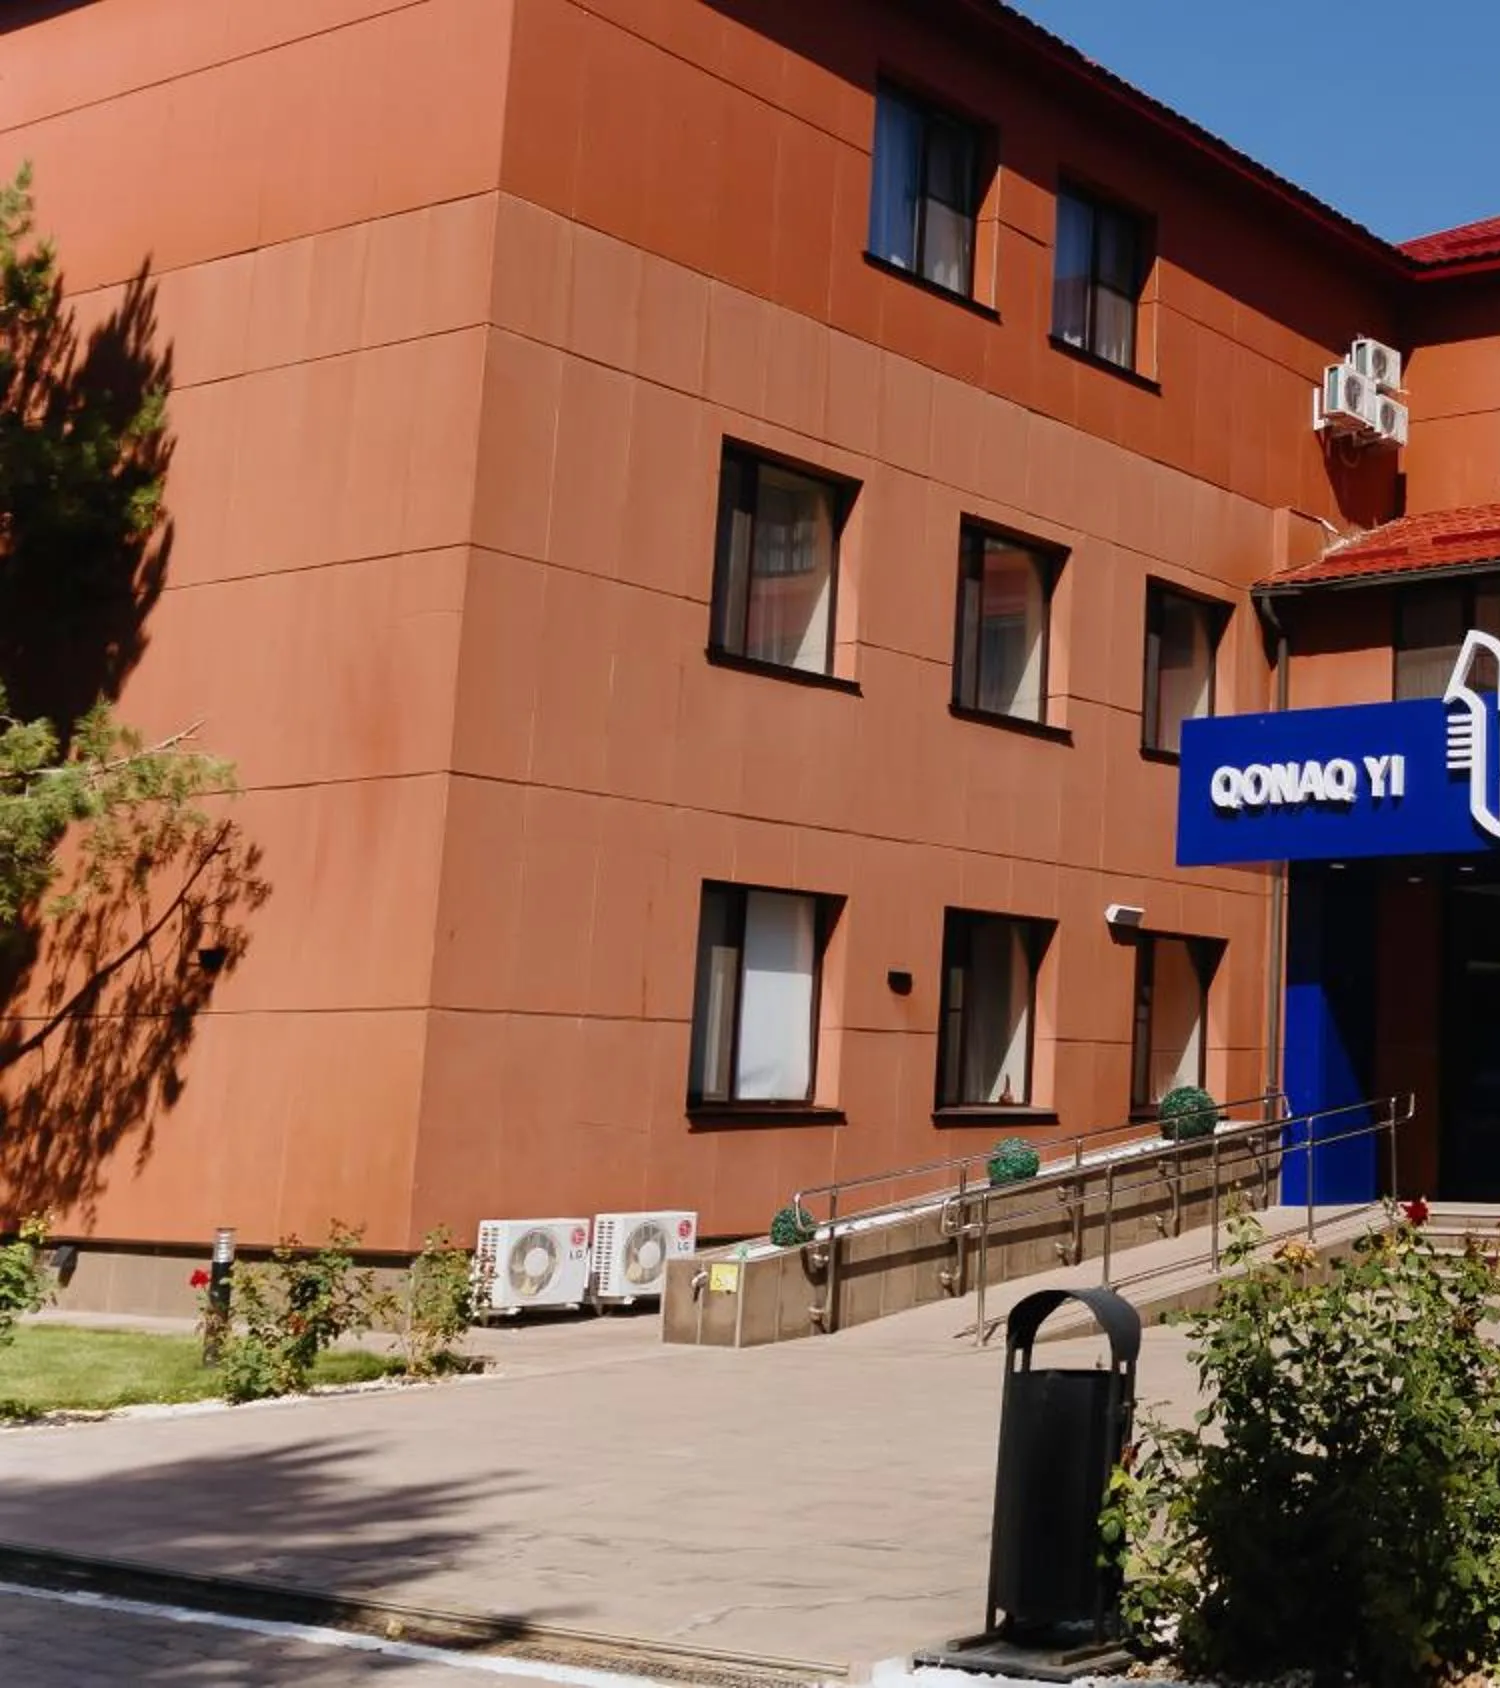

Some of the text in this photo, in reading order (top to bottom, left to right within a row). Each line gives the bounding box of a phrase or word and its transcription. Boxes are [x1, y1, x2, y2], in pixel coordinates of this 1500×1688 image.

[1211, 754, 1404, 809] QONAQ YI
[678, 1241, 689, 1251] LG
[569, 1249, 583, 1260] LG
